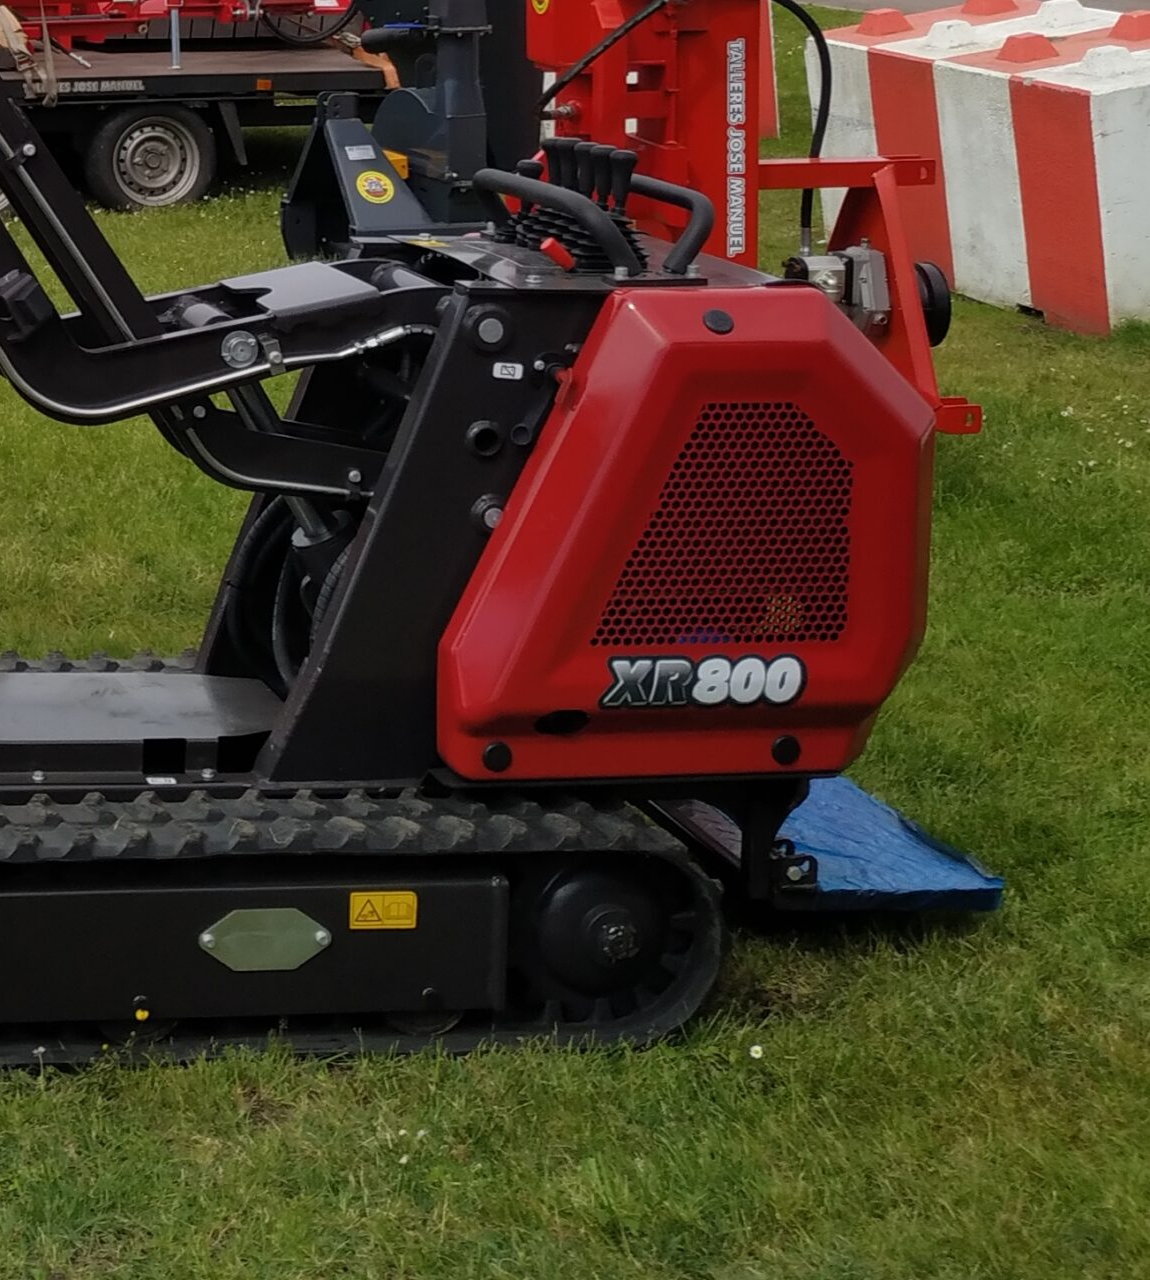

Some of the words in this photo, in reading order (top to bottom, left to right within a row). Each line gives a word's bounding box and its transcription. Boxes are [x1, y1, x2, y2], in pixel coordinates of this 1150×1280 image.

[726, 37, 746, 126] TALLERES
[726, 126, 746, 175] JOSE
[726, 176, 746, 258] MANUEL
[602, 656, 806, 707] XR800
